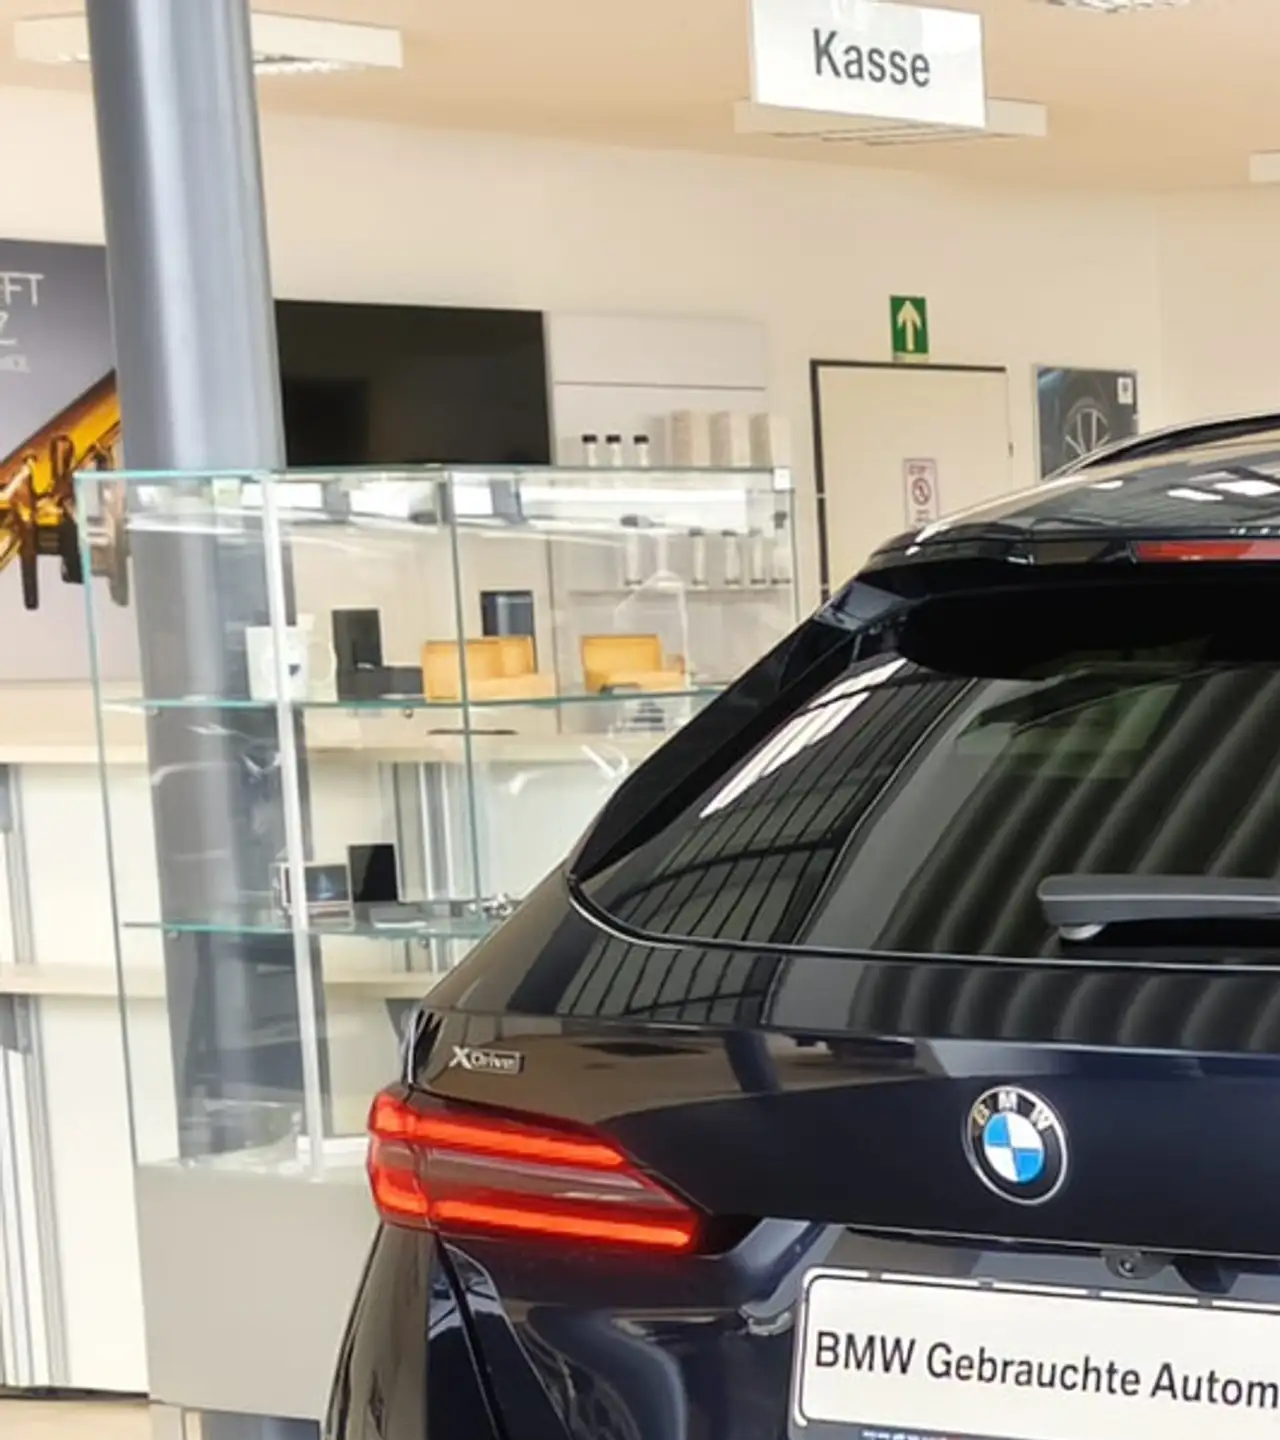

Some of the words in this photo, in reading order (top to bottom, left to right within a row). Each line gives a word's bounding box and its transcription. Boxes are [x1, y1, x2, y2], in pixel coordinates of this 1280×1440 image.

[812, 27, 931, 88] Kasse
[0, 271, 45, 307] FT
[815, 1330, 916, 1374] BMW
[926, 1341, 1142, 1396] Gebrauchte
